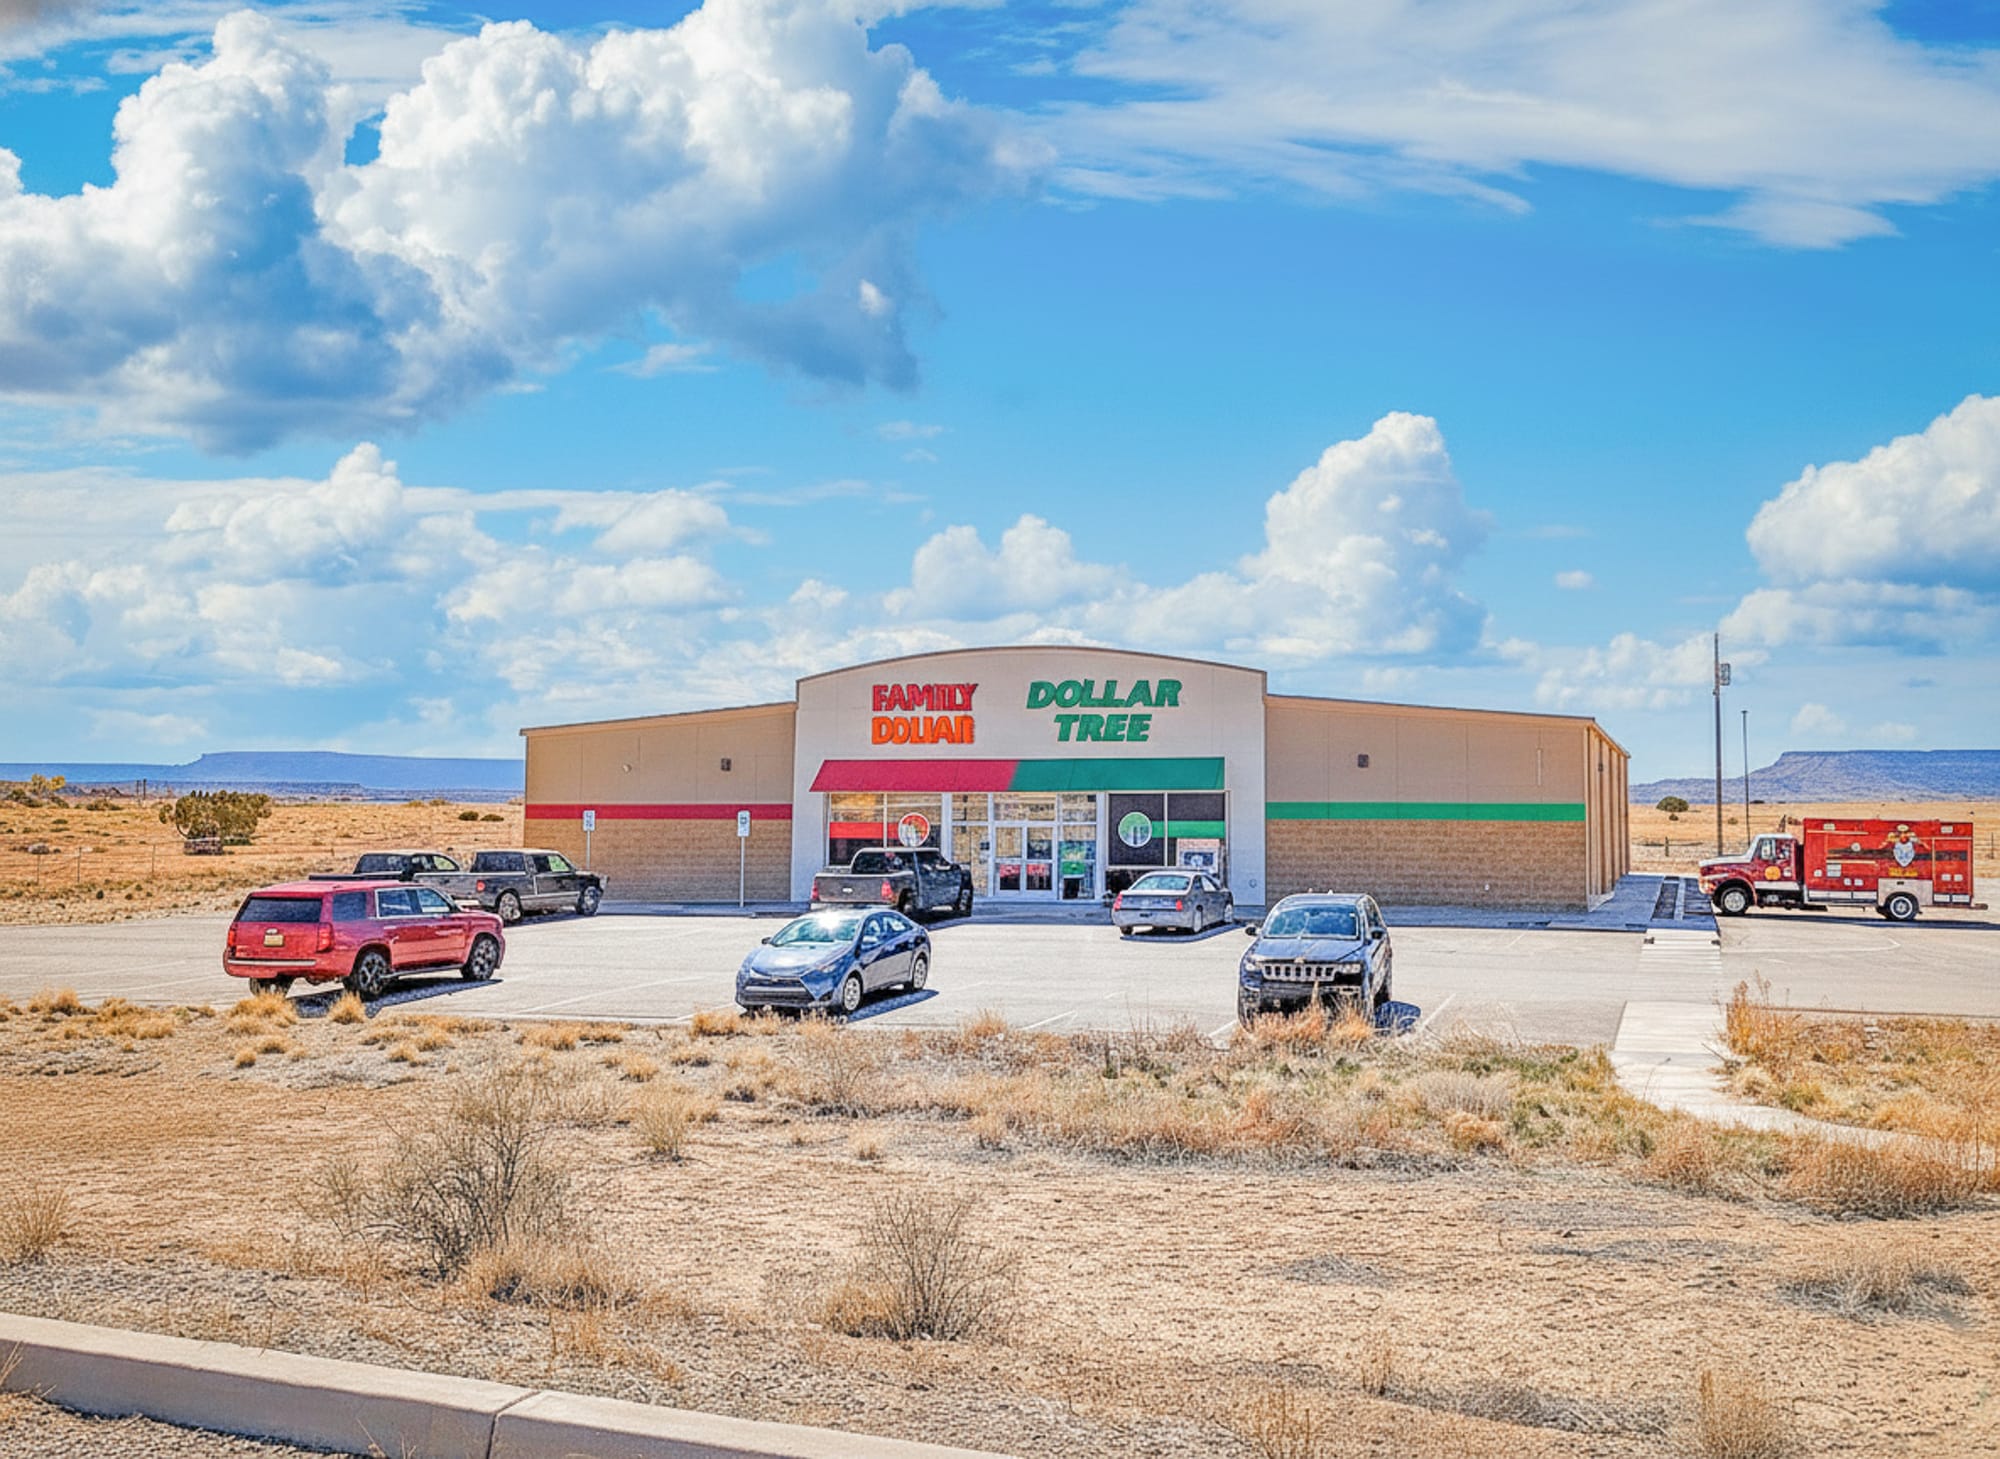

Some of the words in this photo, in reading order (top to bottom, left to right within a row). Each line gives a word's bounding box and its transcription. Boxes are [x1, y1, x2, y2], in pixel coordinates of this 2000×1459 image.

[872, 683, 978, 711] FAMILY
[1026, 679, 1183, 708] DOLLAR
[1053, 714, 1153, 742] TREE
